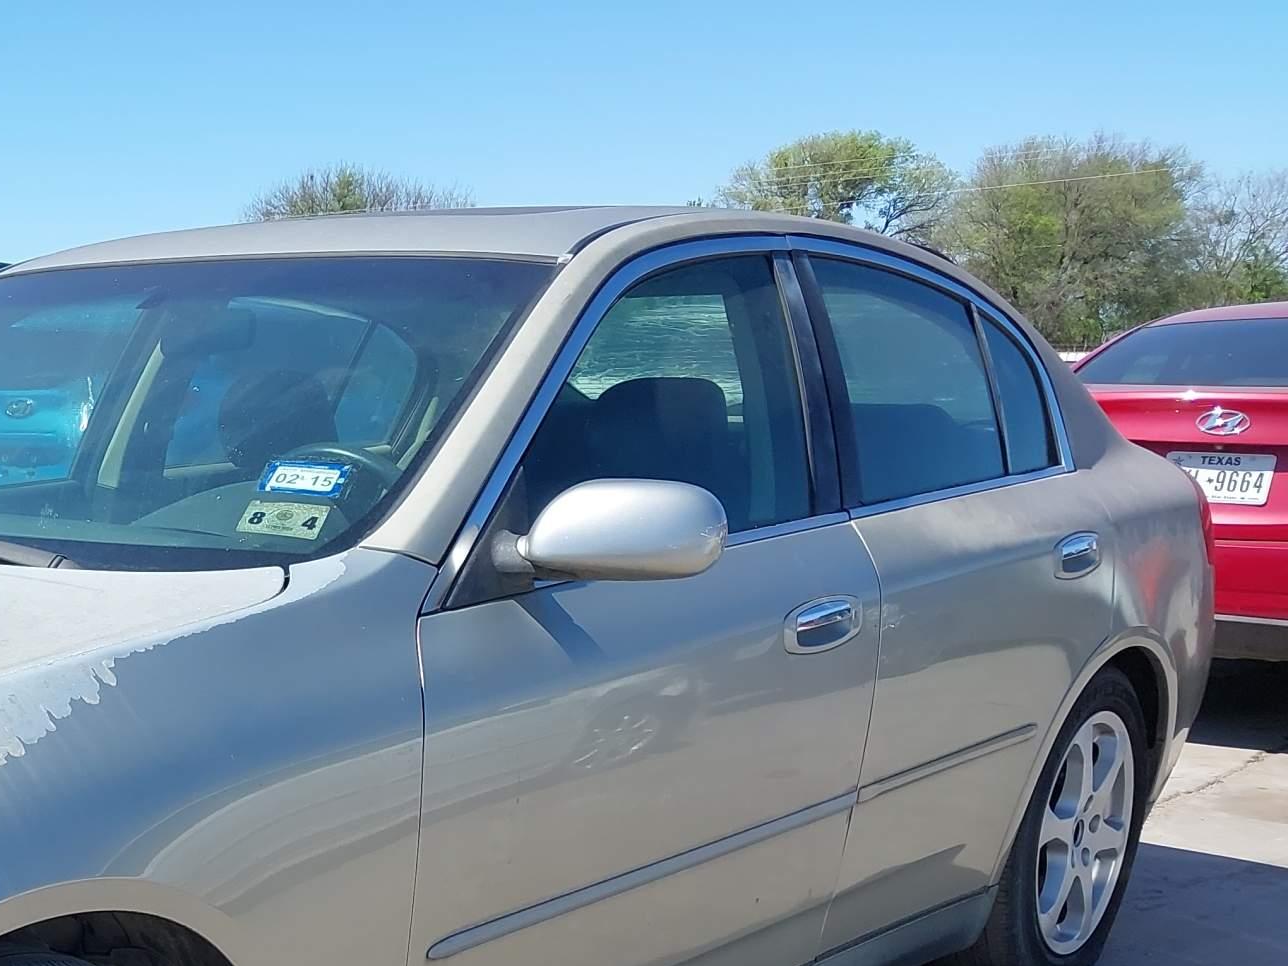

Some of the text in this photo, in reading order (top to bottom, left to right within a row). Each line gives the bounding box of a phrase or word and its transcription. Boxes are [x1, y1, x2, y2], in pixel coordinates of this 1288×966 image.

[1201, 455, 1242, 466] TEXAS
[275, 472, 335, 488] 02 15
[1214, 470, 1264, 494] 9664
[247, 511, 266, 525] 8
[301, 516, 319, 531] 4
